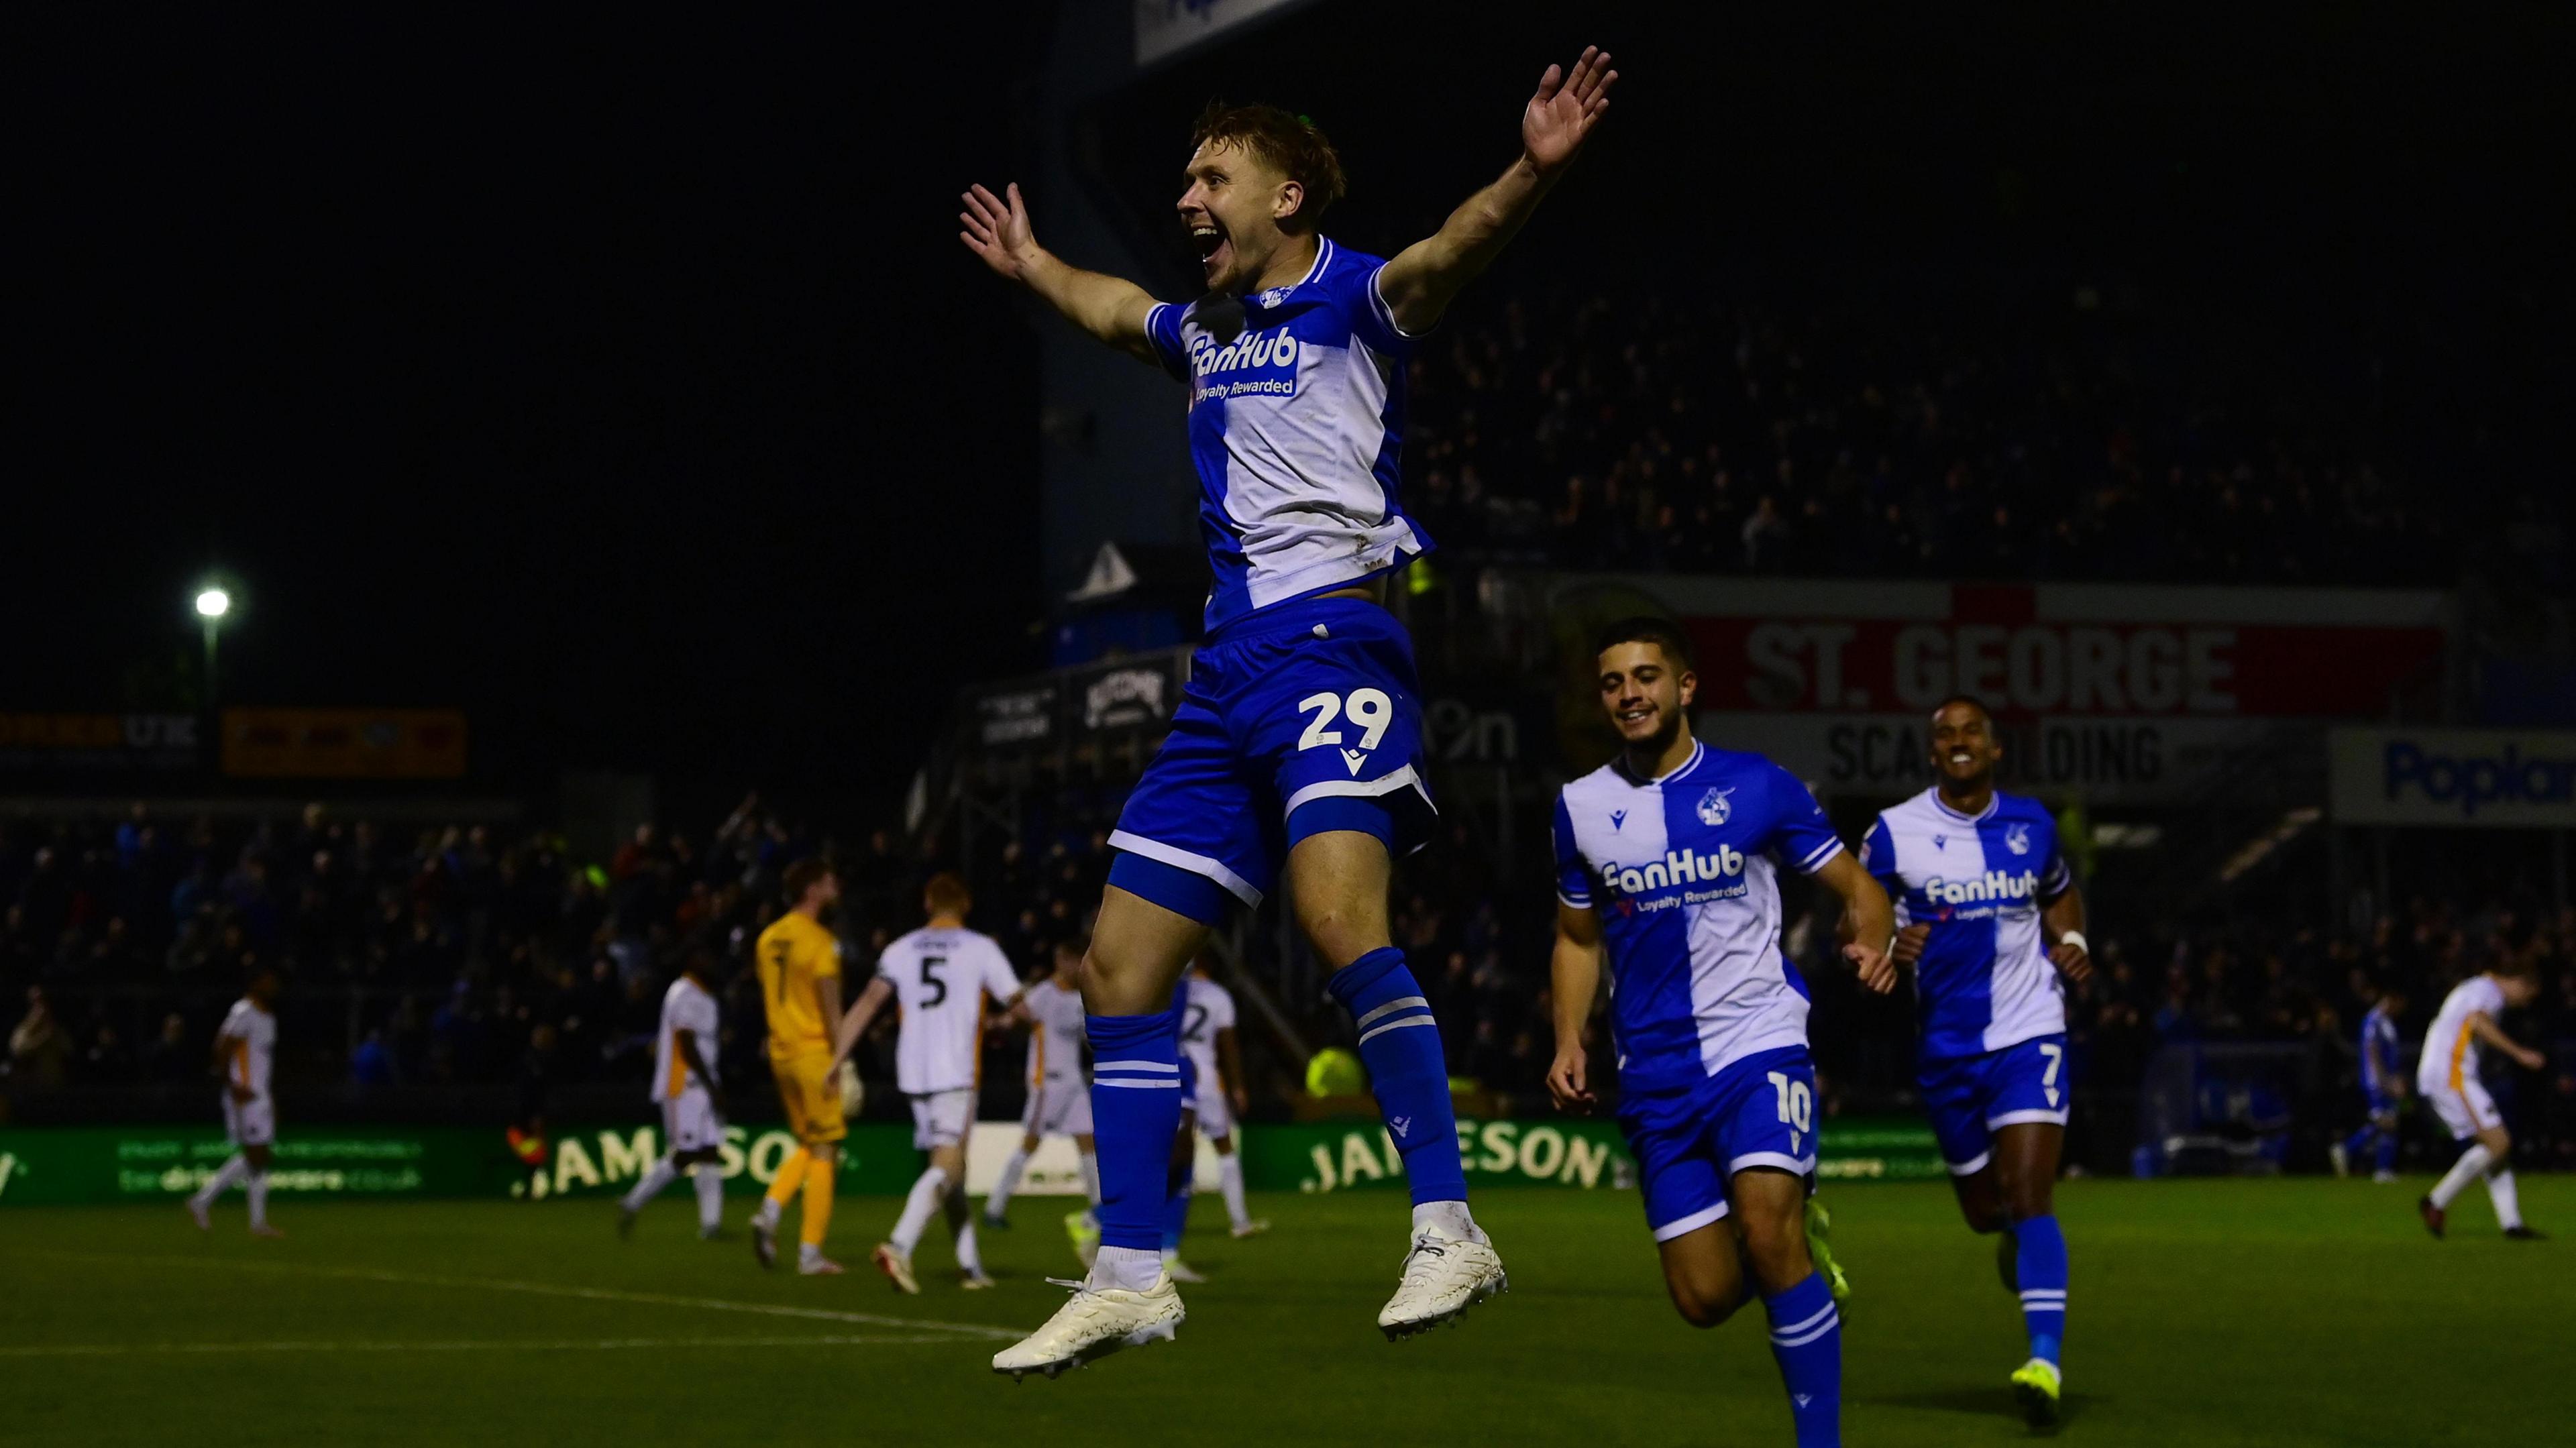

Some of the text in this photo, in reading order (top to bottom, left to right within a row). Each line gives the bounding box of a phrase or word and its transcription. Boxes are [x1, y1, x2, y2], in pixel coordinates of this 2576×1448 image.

[1191, 327, 1297, 377] FanHub
[1196, 379, 1293, 401] Loyalty Rewarded
[1747, 625, 2238, 715] ST. GEORGE
[1298, 687, 1393, 753] 29
[1603, 843, 1745, 894] FanHub
[1684, 884, 1746, 905] Rewarded
[920, 956, 947, 1009] 5
[2039, 1043, 2062, 1087] 7
[1766, 1070, 1812, 1133] 10
